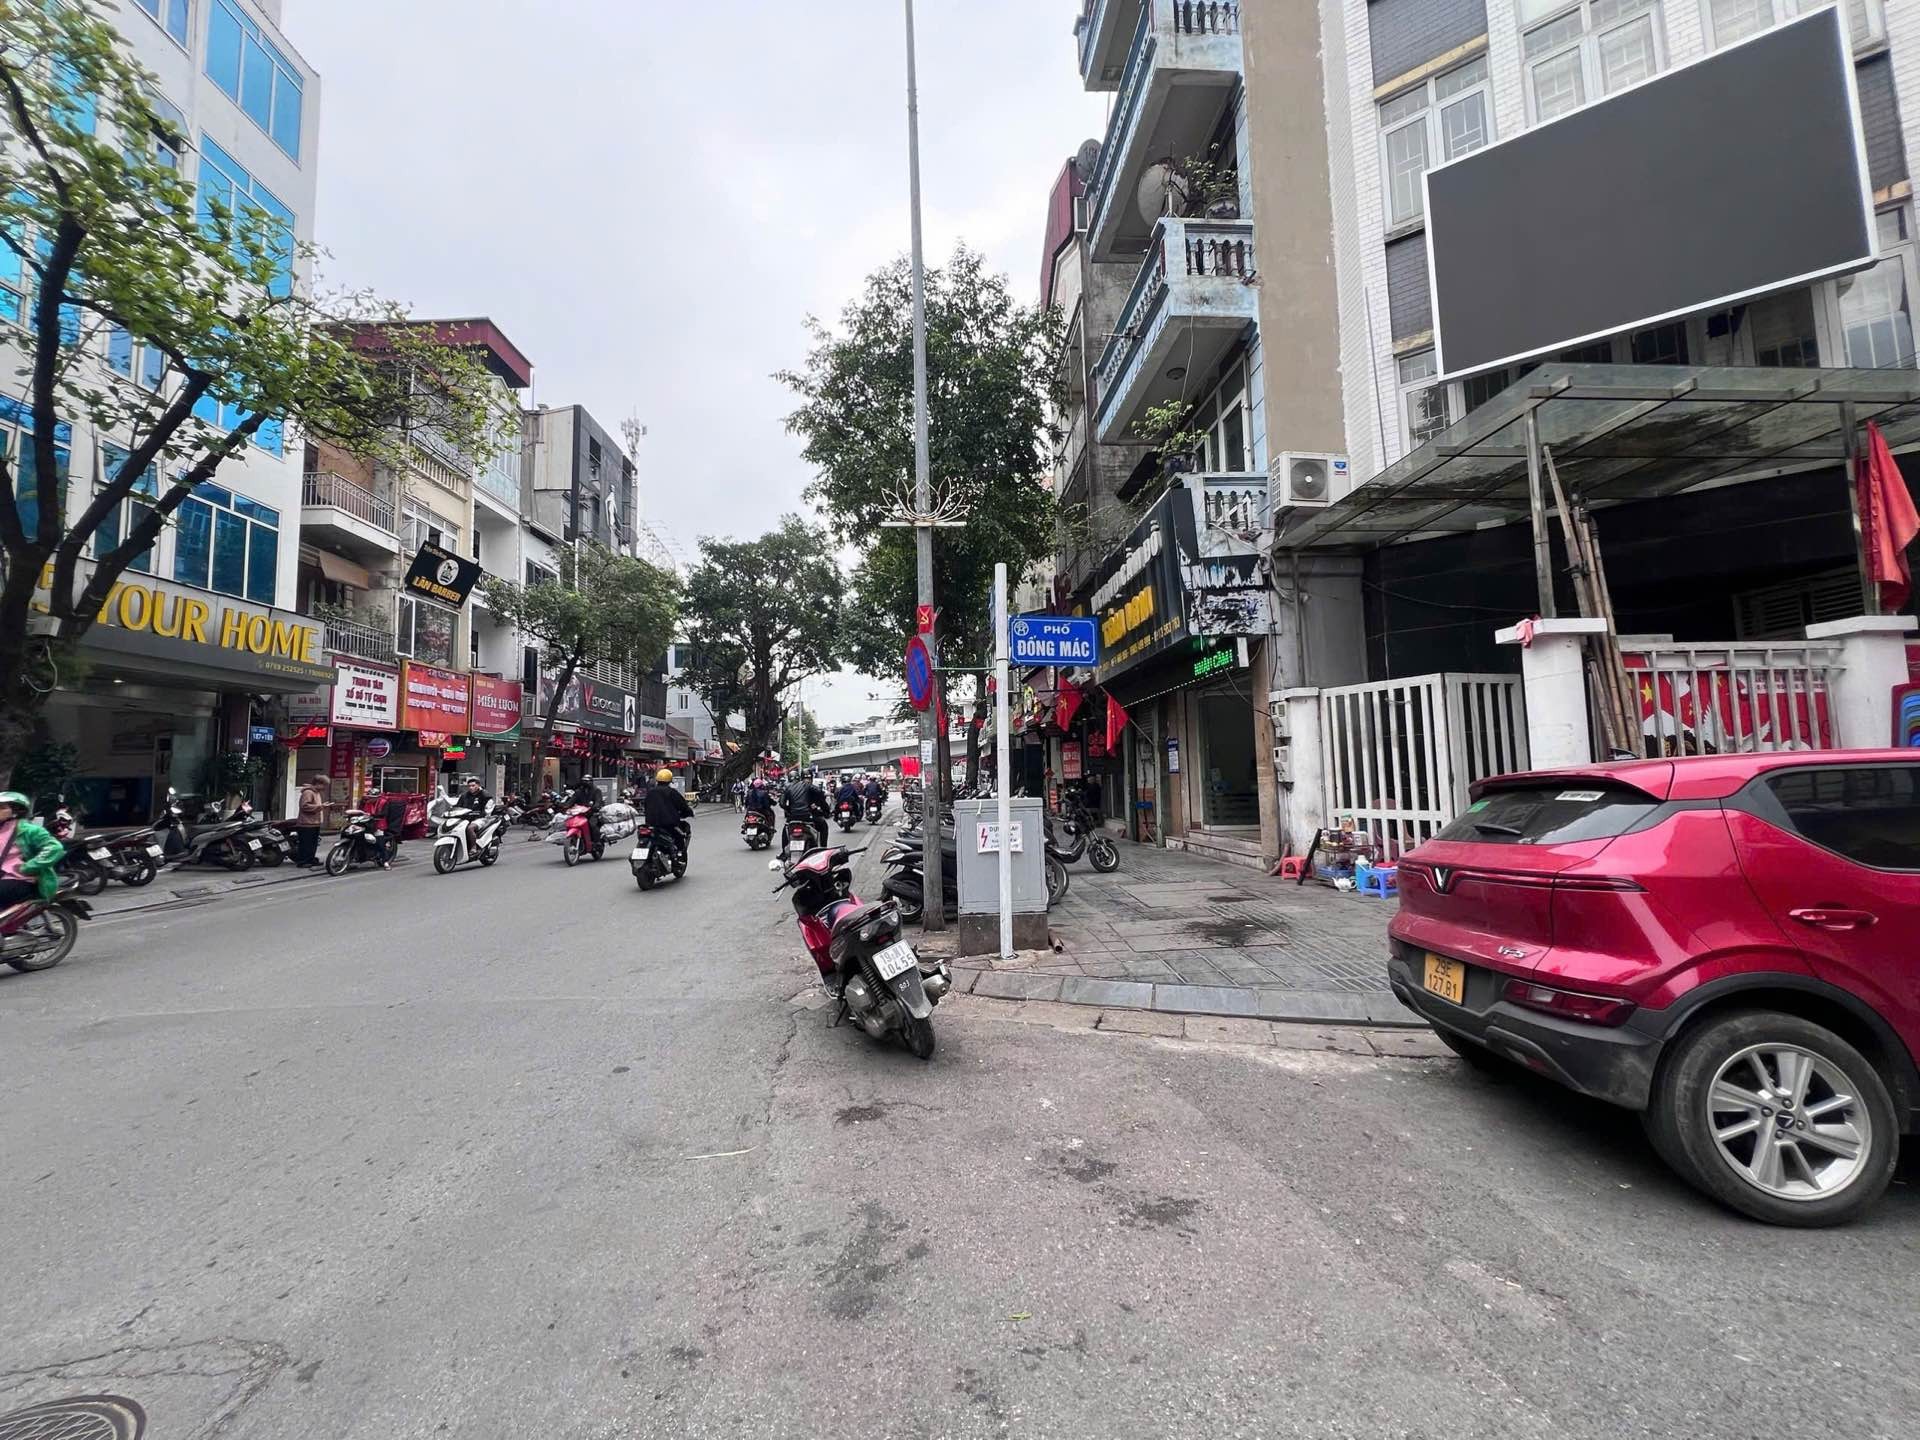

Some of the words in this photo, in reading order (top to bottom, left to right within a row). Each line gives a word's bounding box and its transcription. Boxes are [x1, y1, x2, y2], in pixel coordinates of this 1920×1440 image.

[97, 581, 209, 644] YOUR
[220, 607, 320, 664] HOME
[1043, 623, 1071, 635] PHỐ
[1017, 635, 1056, 657] ĐỐNG
[1059, 637, 1090, 658] MÁC
[477, 693, 497, 709] MIẾN
[1434, 958, 1454, 978] 29E
